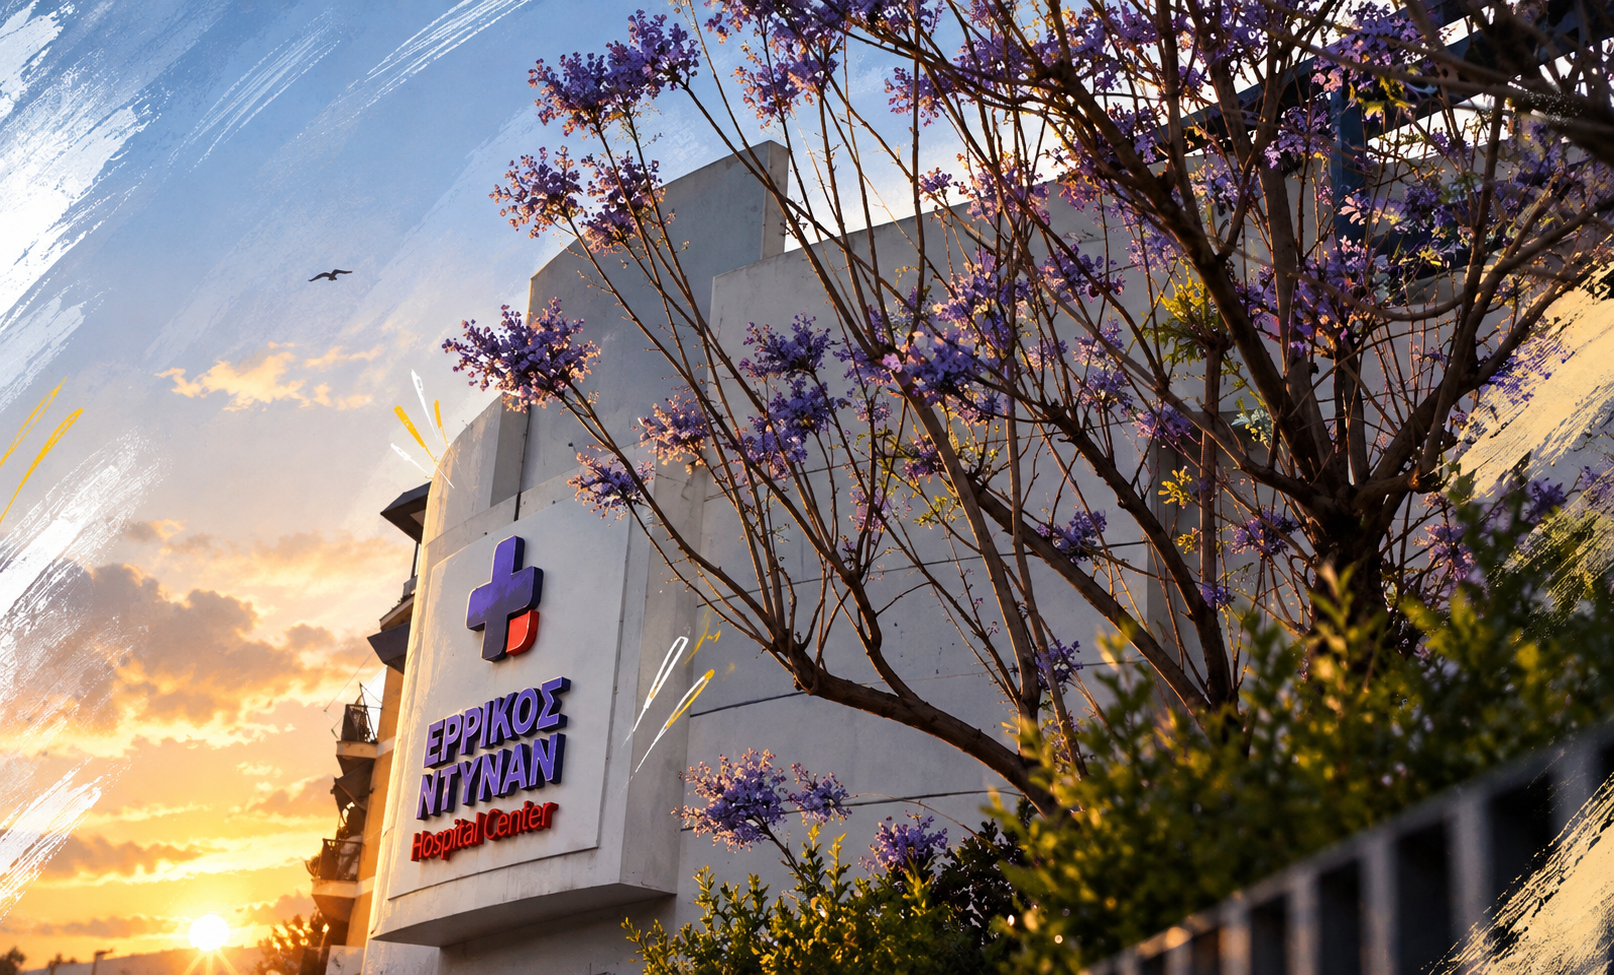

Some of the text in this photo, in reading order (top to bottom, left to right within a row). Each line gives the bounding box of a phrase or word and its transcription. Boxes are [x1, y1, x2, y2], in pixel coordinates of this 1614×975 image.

[424, 676, 571, 768] ΕΡΡΙΚΟΣ
[416, 733, 566, 820] ΝΤΥΝΑΝ
[411, 801, 559, 861] Hospital Center
